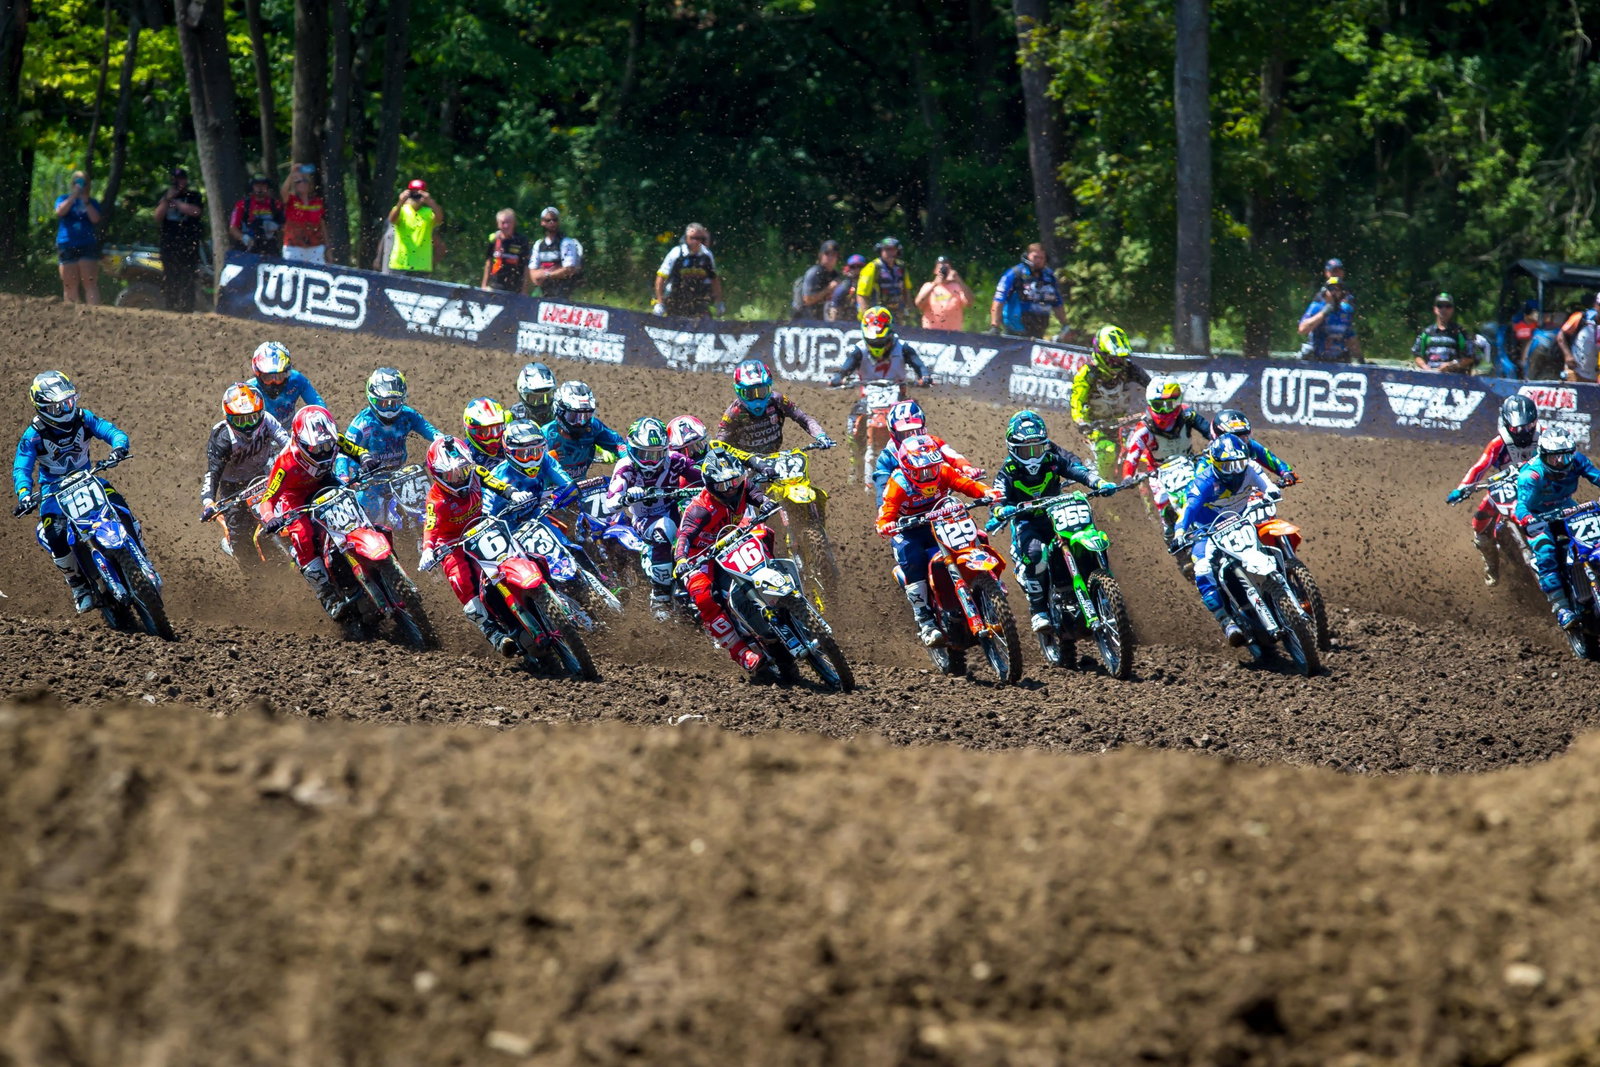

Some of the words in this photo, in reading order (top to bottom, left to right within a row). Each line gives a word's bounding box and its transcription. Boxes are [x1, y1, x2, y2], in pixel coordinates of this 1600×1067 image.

[255, 263, 368, 330] WPS
[384, 288, 504, 332] FLY
[542, 305, 583, 326] LUCAS
[406, 322, 478, 342] RACING
[644, 326, 760, 366] FLY
[1261, 367, 1367, 428] WPS
[1381, 382, 1486, 421] FLY
[1396, 415, 1462, 431] RACING
[60, 482, 105, 519] 191
[1051, 504, 1091, 531] 355
[1568, 516, 1600, 540] 23
[478, 529, 507, 560] 6
[936, 519, 978, 548] 129
[728, 541, 763, 573] 16
